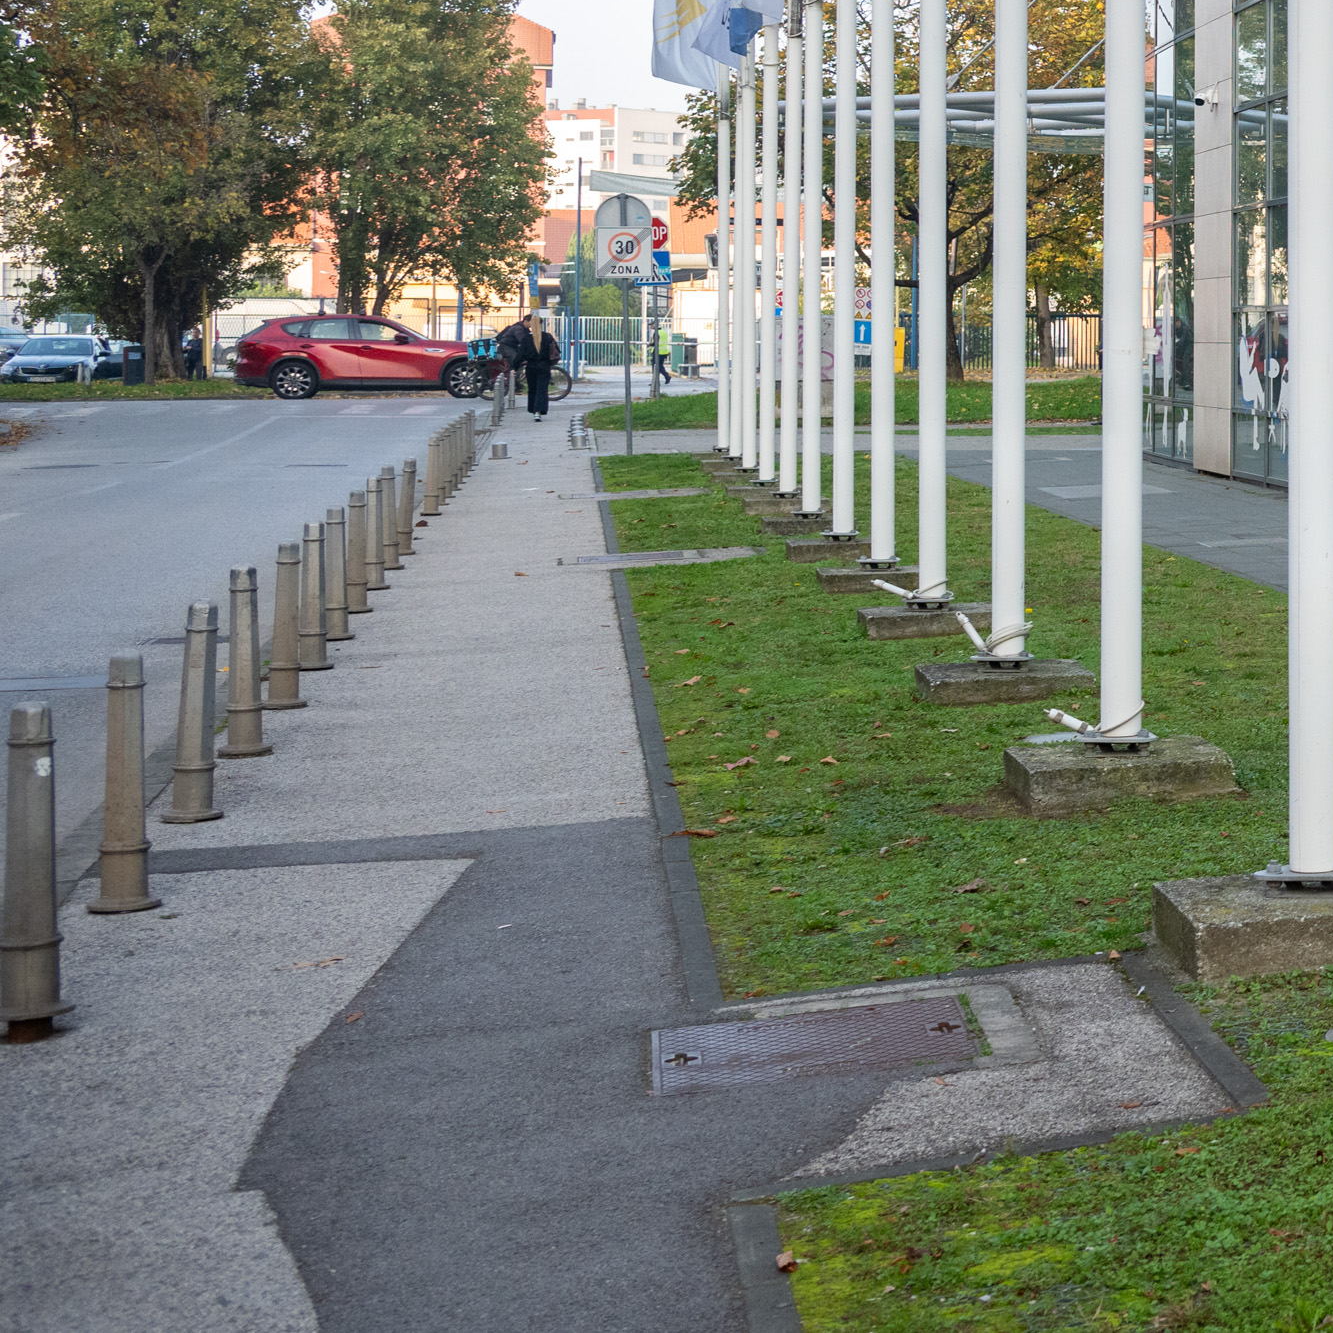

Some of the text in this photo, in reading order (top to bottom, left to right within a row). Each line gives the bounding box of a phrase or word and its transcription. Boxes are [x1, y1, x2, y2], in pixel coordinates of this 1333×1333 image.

[652, 226, 667, 240] OP
[615, 240, 634, 254] 30
[610, 265, 640, 274] ZONA
